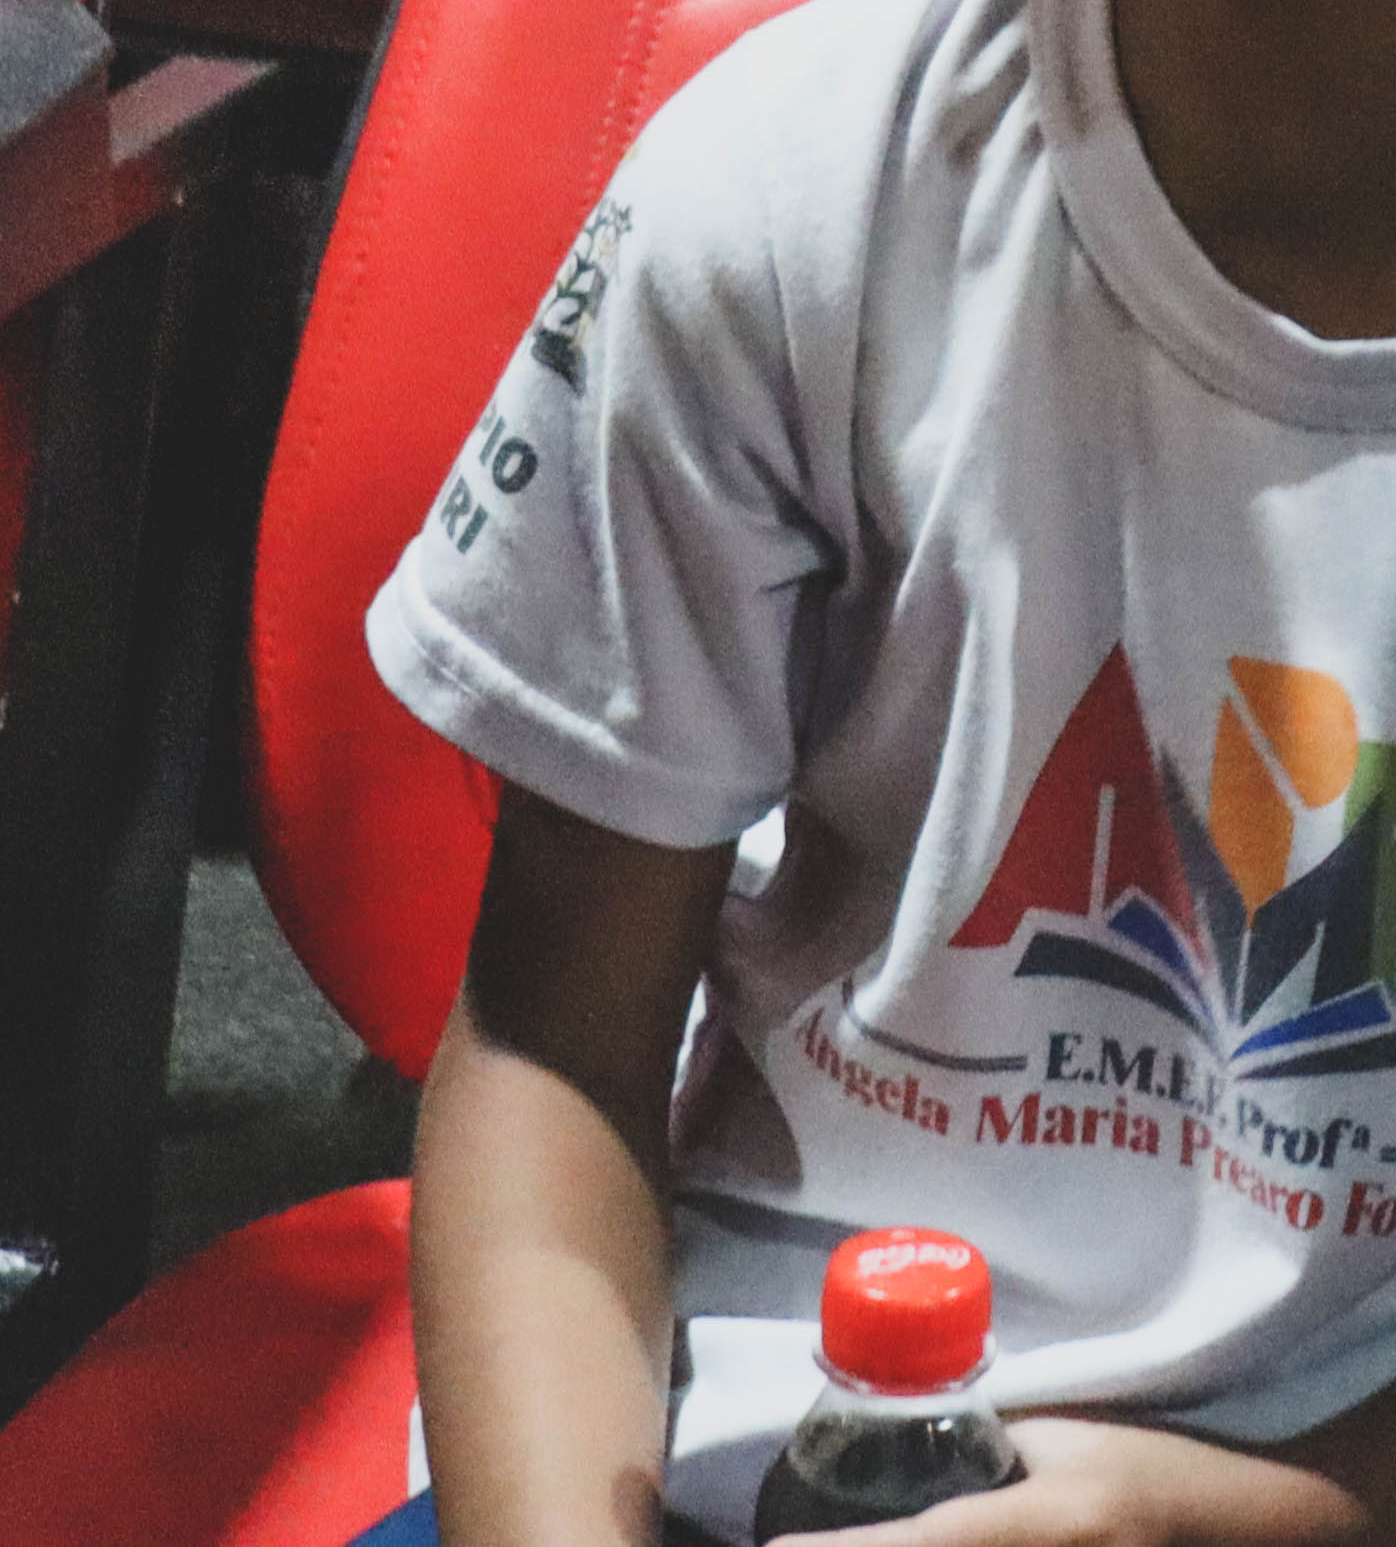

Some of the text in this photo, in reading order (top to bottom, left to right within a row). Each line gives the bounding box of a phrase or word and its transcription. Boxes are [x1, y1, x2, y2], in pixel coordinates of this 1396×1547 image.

[795, 1005, 951, 1138] Angela
[975, 1091, 1161, 1156] Maria
[1180, 1114, 1326, 1232] Prearo
